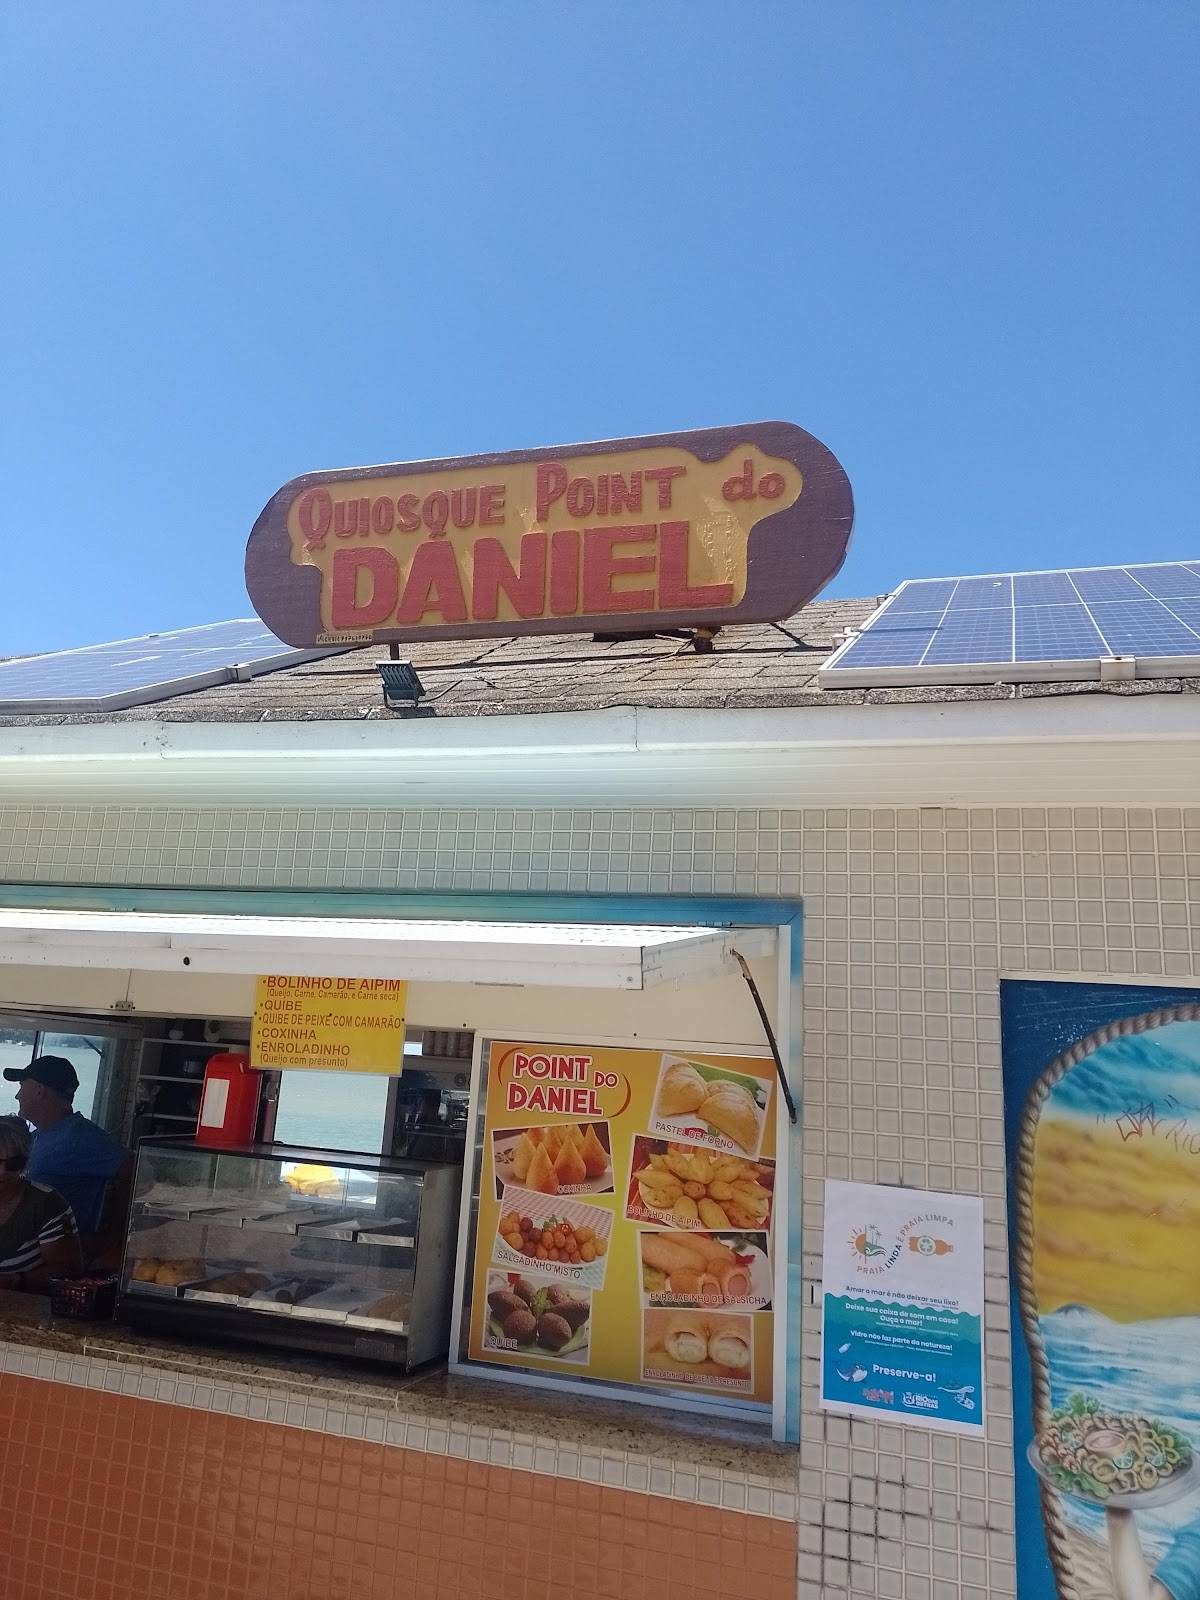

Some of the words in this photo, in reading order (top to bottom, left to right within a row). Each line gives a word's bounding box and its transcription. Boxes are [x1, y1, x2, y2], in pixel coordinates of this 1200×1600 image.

[300, 485, 505, 551] QUIOSQUE
[536, 463, 687, 521] POINT
[722, 458, 785, 502] do
[331, 522, 734, 629] DANIEL
[267, 976, 332, 989] BOLINHO
[337, 978, 356, 990] DE
[360, 979, 401, 991] AIPIM
[264, 1000, 302, 1011] QUIBE
[262, 1013, 288, 1025] QUIBE
[291, 1014, 302, 1025] DE
[305, 1015, 331, 1026] PEIXE
[333, 1015, 354, 1027] COM
[355, 1015, 401, 1029] CAMARÃO
[261, 1028, 317, 1040] COXINHA
[261, 1041, 350, 1056] ENROLADINHO
[260, 1053, 288, 1066] (Queijo
[290, 1057, 306, 1065] com
[309, 1057, 348, 1068] presunto)
[514, 1054, 592, 1081] POINT
[594, 1071, 618, 1088] DO
[508, 1083, 603, 1115] DANIEL
[655, 1121, 687, 1137] PASTEL
[689, 1130, 700, 1140] DE
[703, 1133, 734, 1149] FORNO
[627, 1205, 664, 1220] BOLINHO
[665, 1212, 677, 1222] DE
[857, 1266, 885, 1275] PRAIA
[885, 1244, 902, 1269] LINDA
[901, 1215, 924, 1236] PRAIA
[925, 1214, 954, 1226] LIMPA
[497, 1250, 552, 1272] SALGADINHO
[553, 1267, 581, 1279] MISTO
[650, 1293, 711, 1304] ENROLADINHO
[725, 1296, 767, 1305] SALSICHA
[846, 1285, 865, 1293] Amar
[871, 1289, 885, 1297] mar
[907, 1293, 928, 1302] deixar
[879, 1308, 899, 1317] caixa
[909, 1312, 925, 1320] som
[926, 1314, 938, 1322] em
[880, 1315, 898, 1324] Ouça
[850, 1330, 868, 1338] Vidro
[892, 1336, 910, 1345] parte
[911, 1338, 920, 1346] da
[872, 1364, 936, 1383] Preserve-a!
